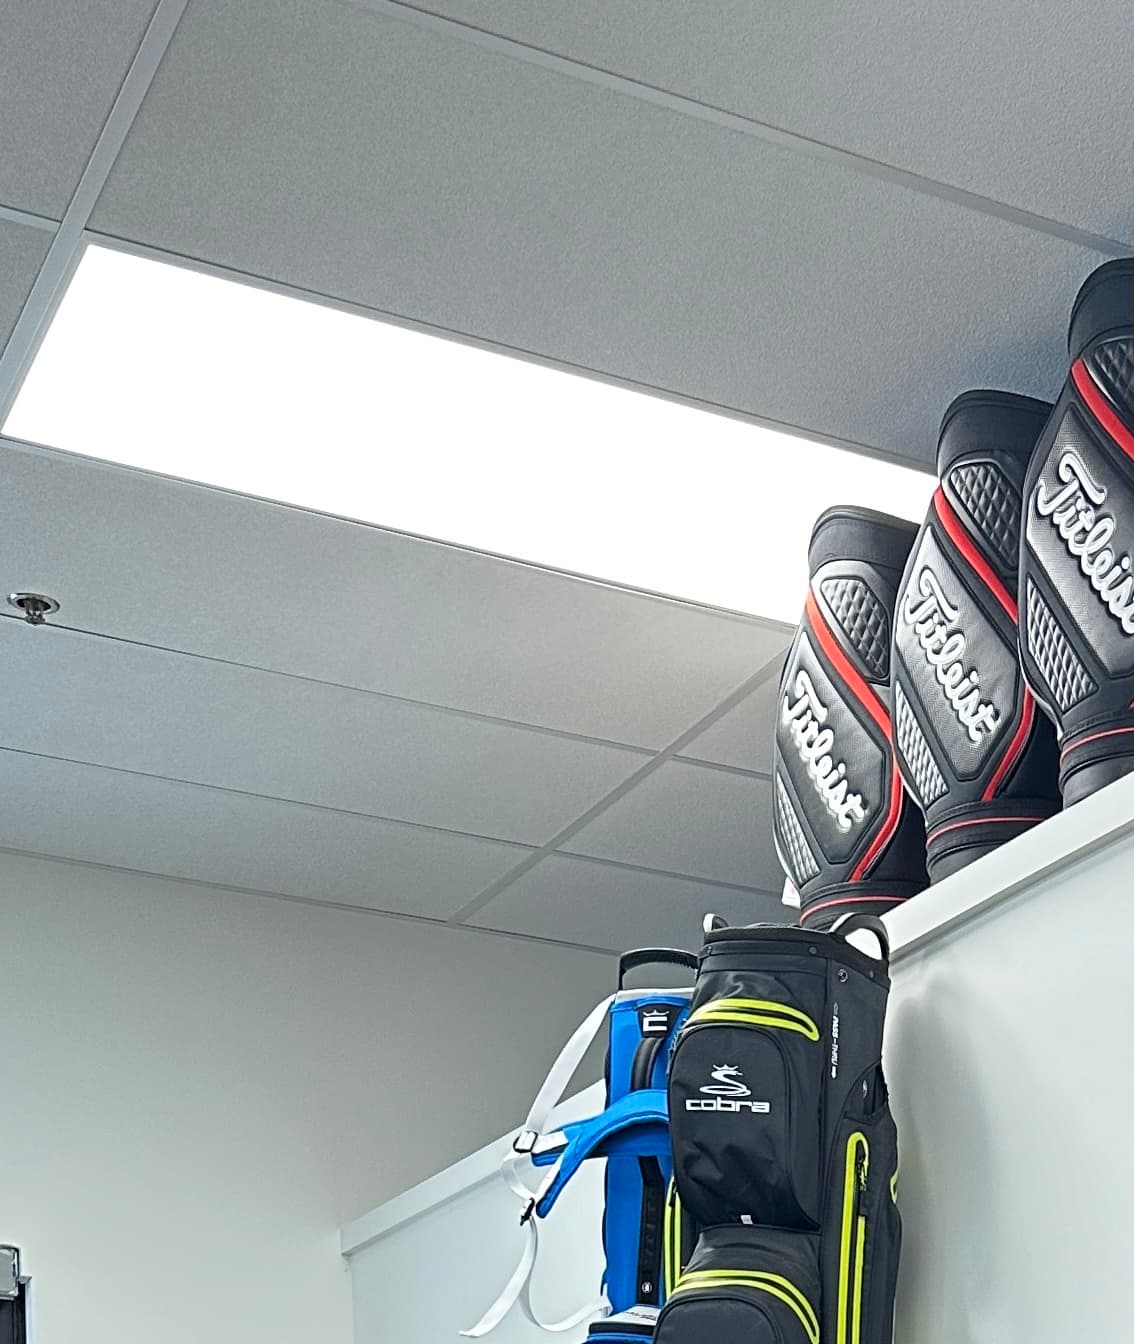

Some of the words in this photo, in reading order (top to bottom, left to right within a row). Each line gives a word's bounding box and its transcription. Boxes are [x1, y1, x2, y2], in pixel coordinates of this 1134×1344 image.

[902, 565, 1000, 745] Titleist
[783, 668, 867, 833] Titleist
[685, 1096, 771, 1114] cobra
